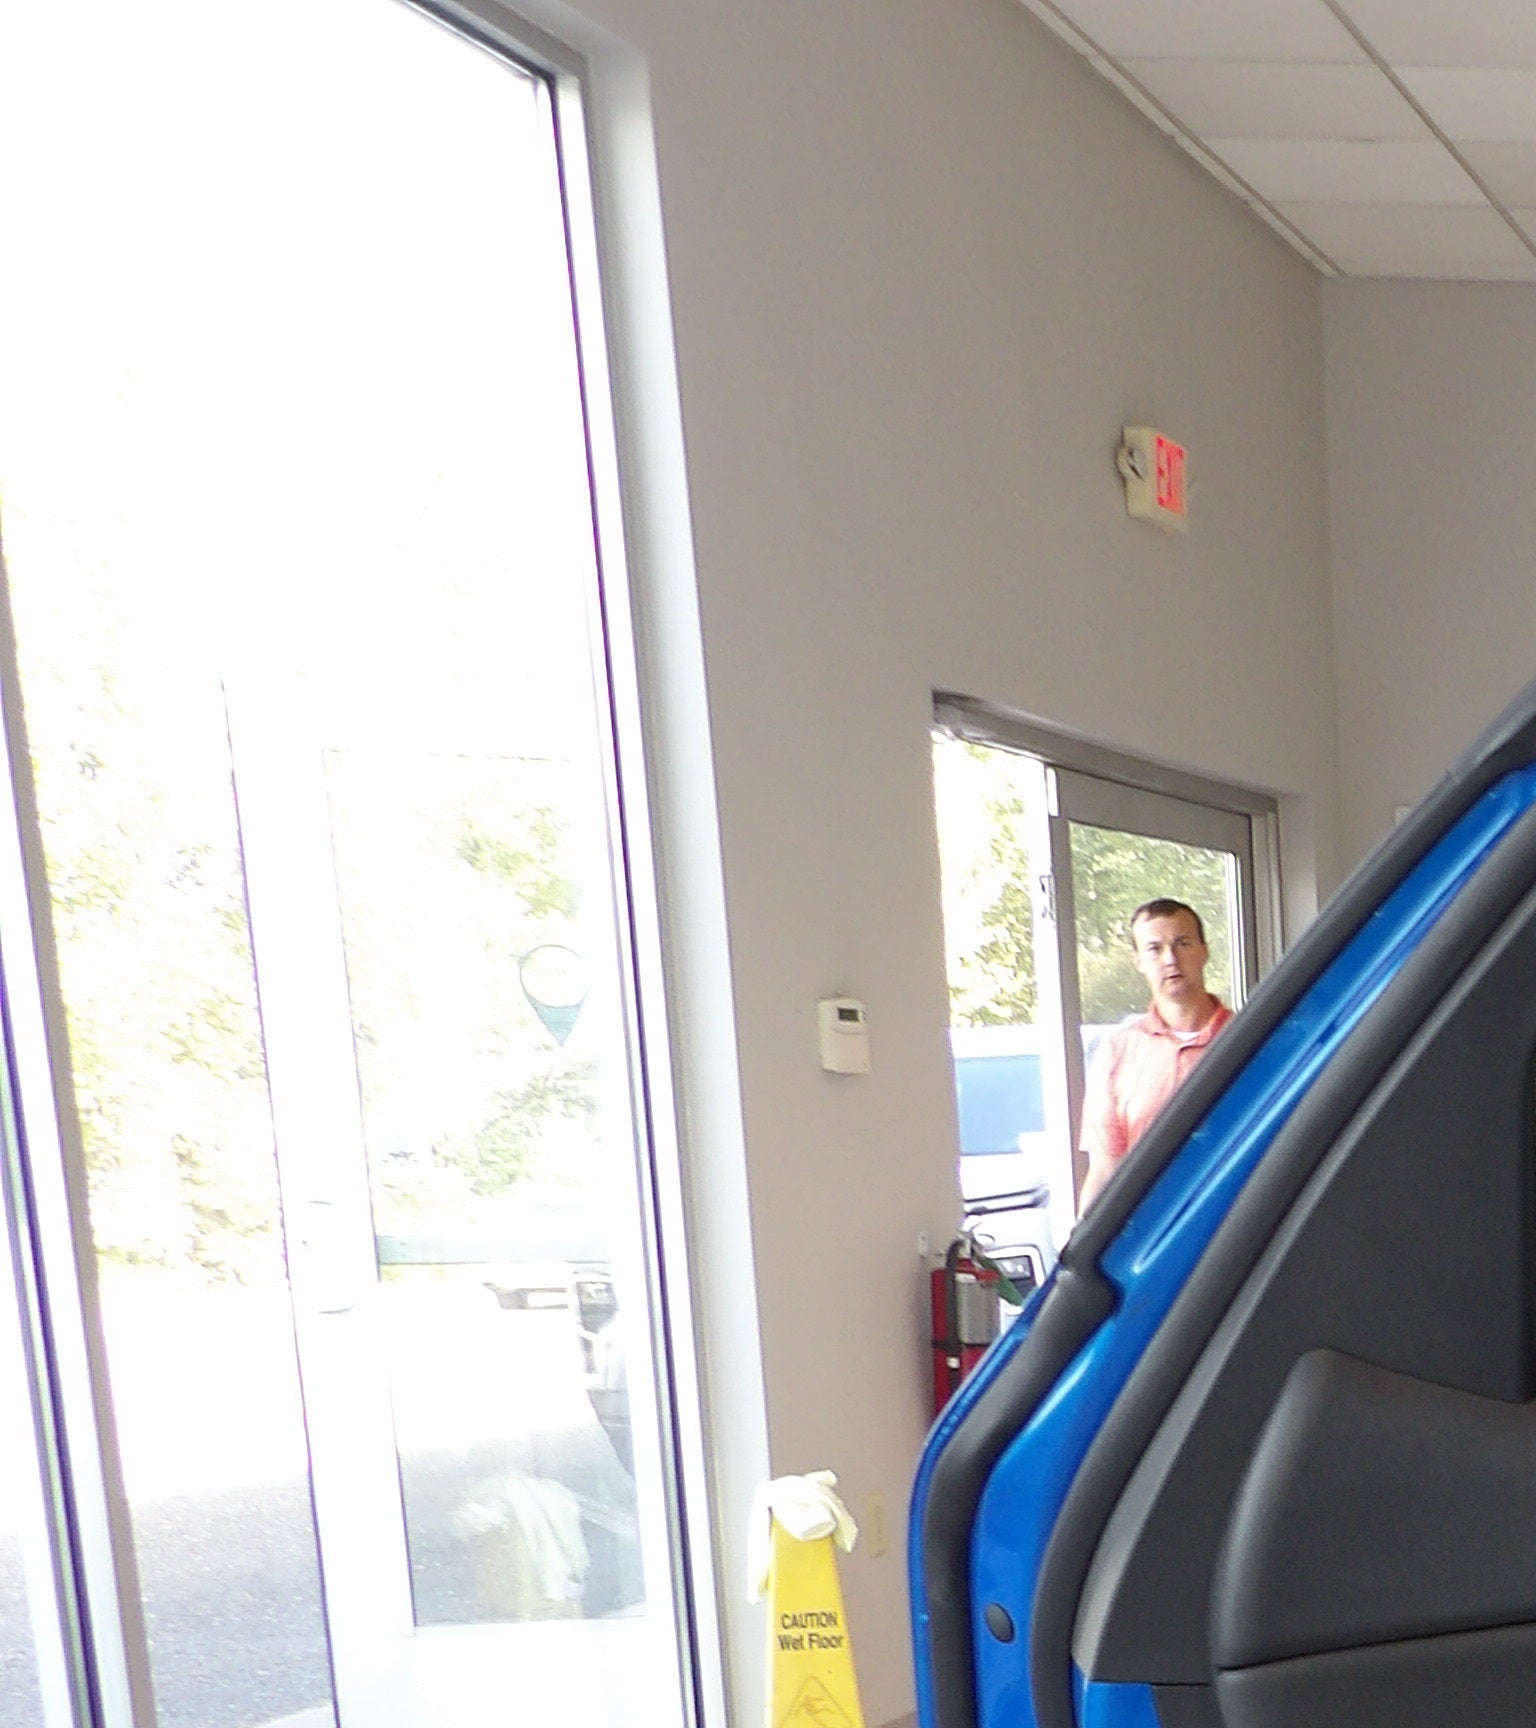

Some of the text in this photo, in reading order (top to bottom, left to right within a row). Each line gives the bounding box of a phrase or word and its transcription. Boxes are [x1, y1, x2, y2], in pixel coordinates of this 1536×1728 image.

[781, 1611, 838, 1630] CAUTION
[778, 1632, 844, 1651] Wet Floor
